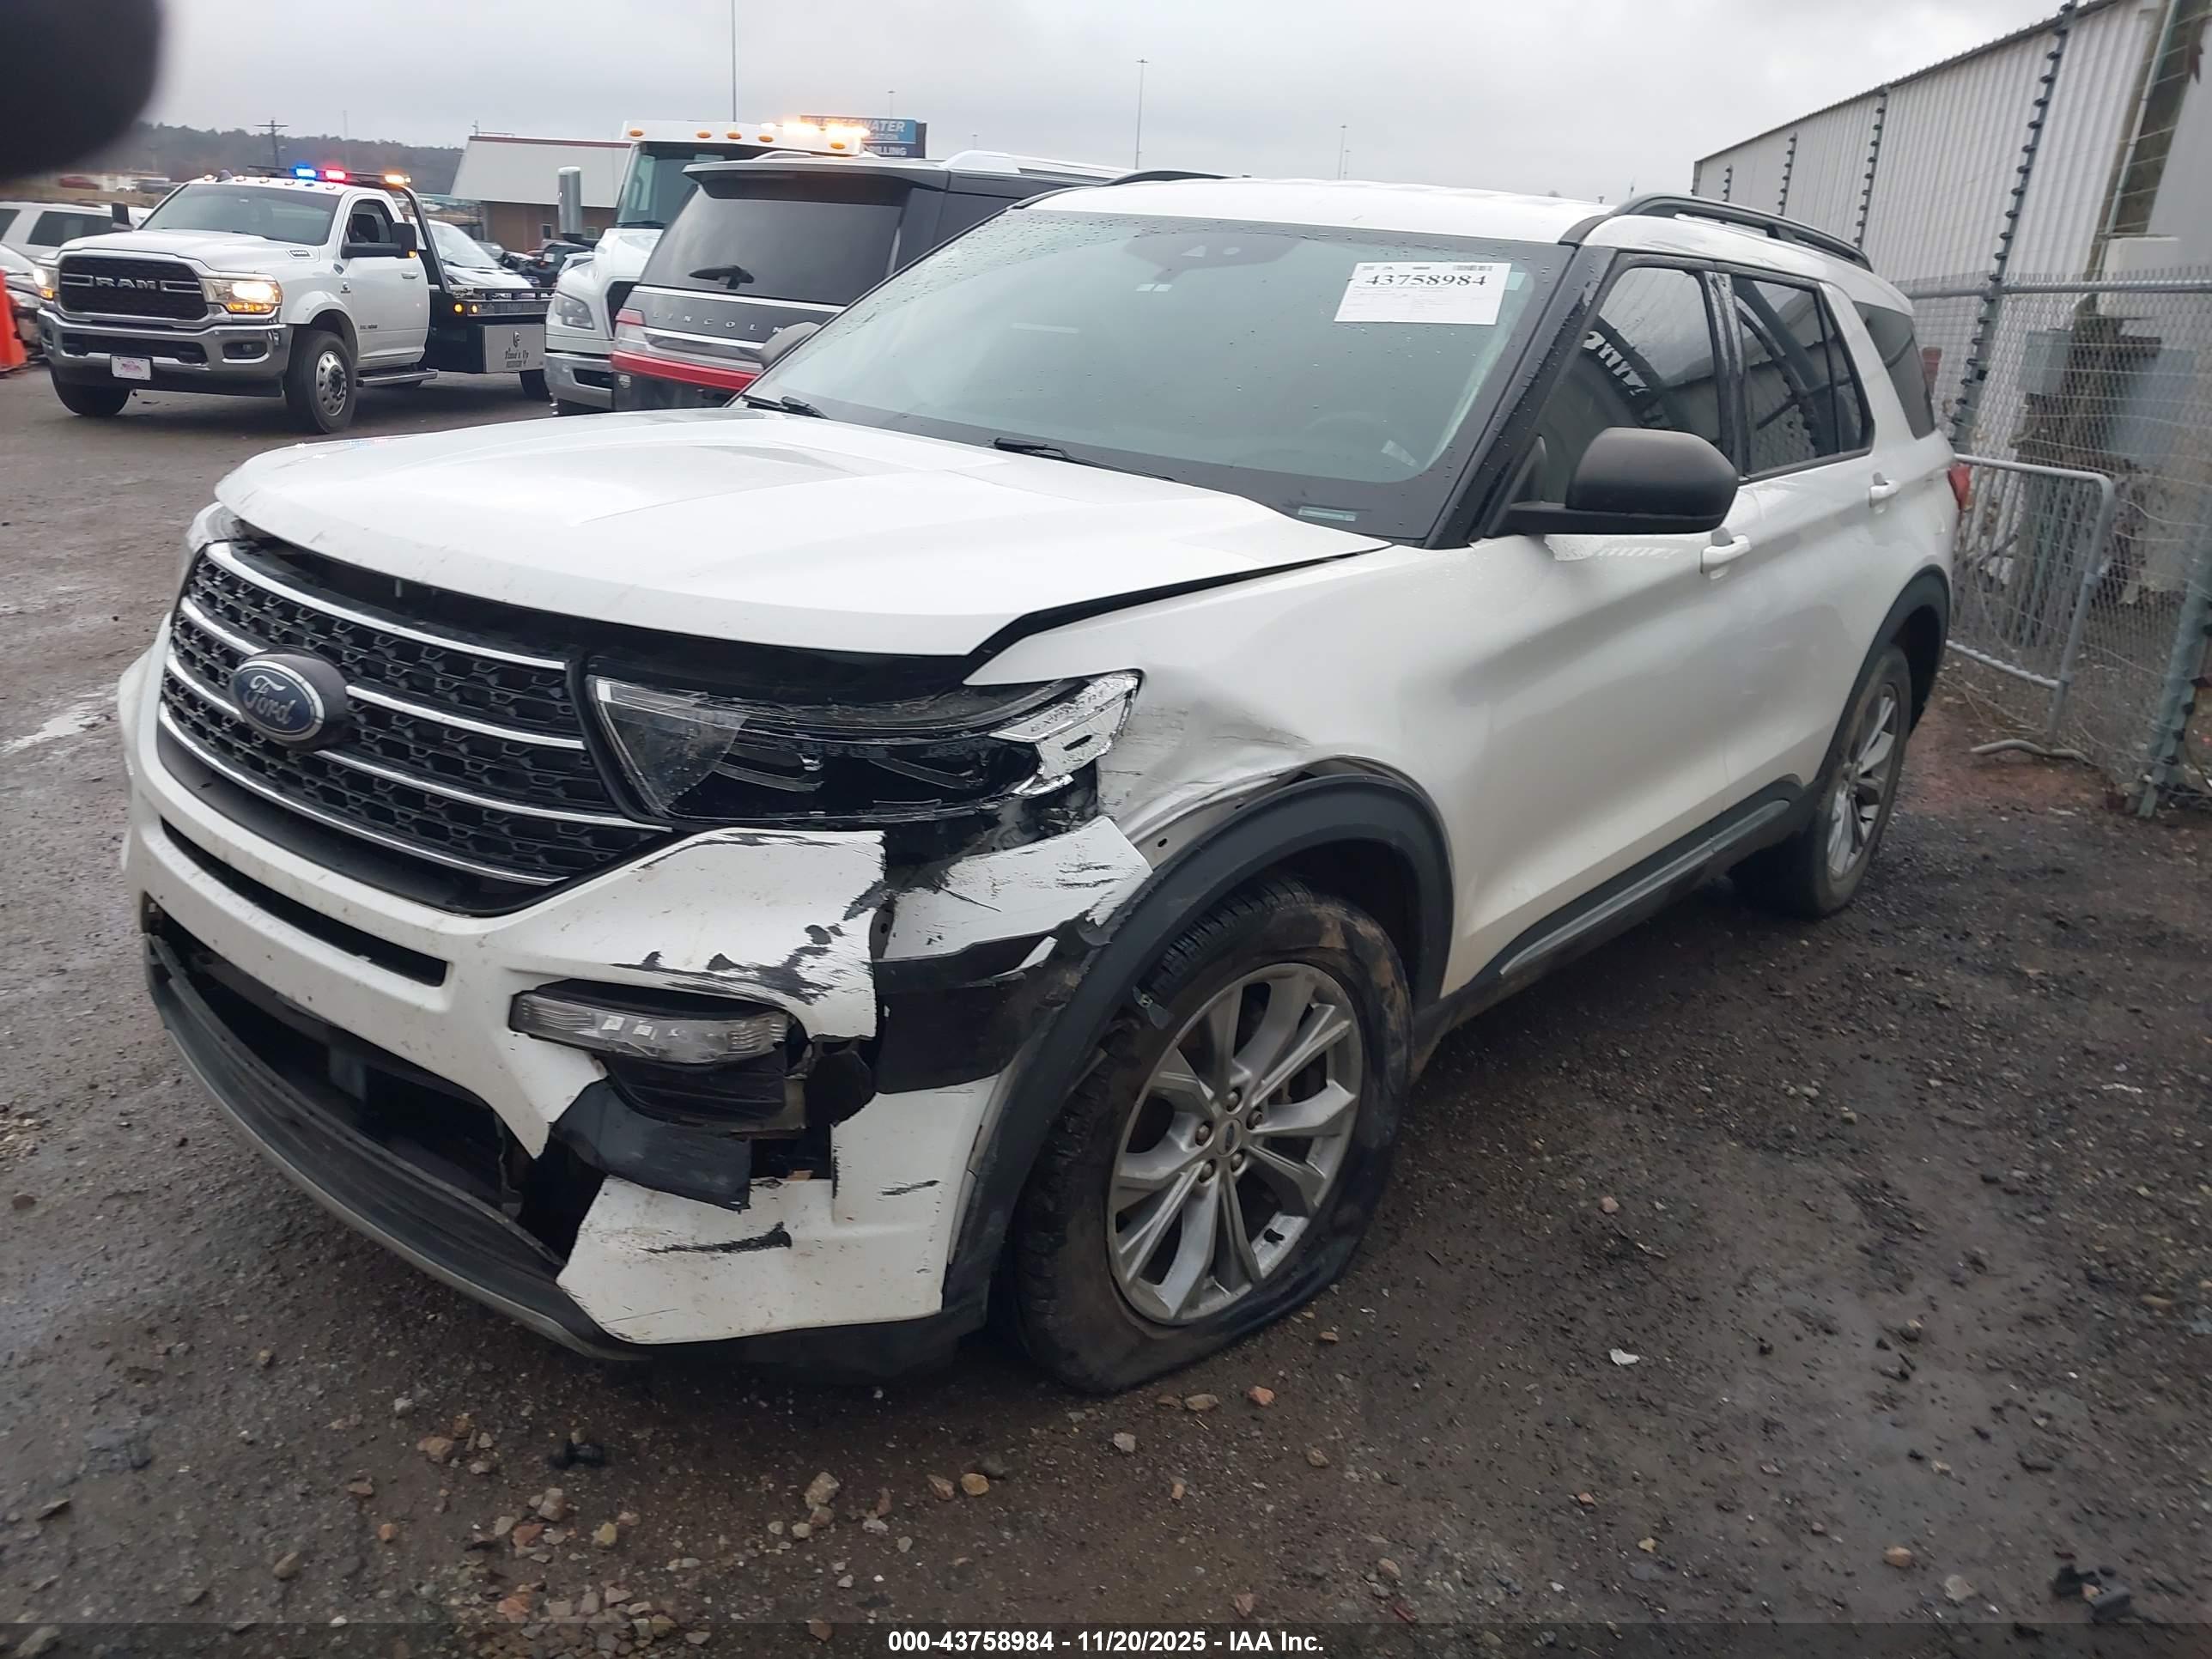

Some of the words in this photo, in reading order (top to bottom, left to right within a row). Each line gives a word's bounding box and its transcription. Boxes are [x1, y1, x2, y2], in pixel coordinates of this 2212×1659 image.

[95, 276, 156, 289] RAM
[1365, 273, 1488, 287] 43758984
[652, 310, 785, 334] LINCOLN
[243, 675, 296, 725] Ford
